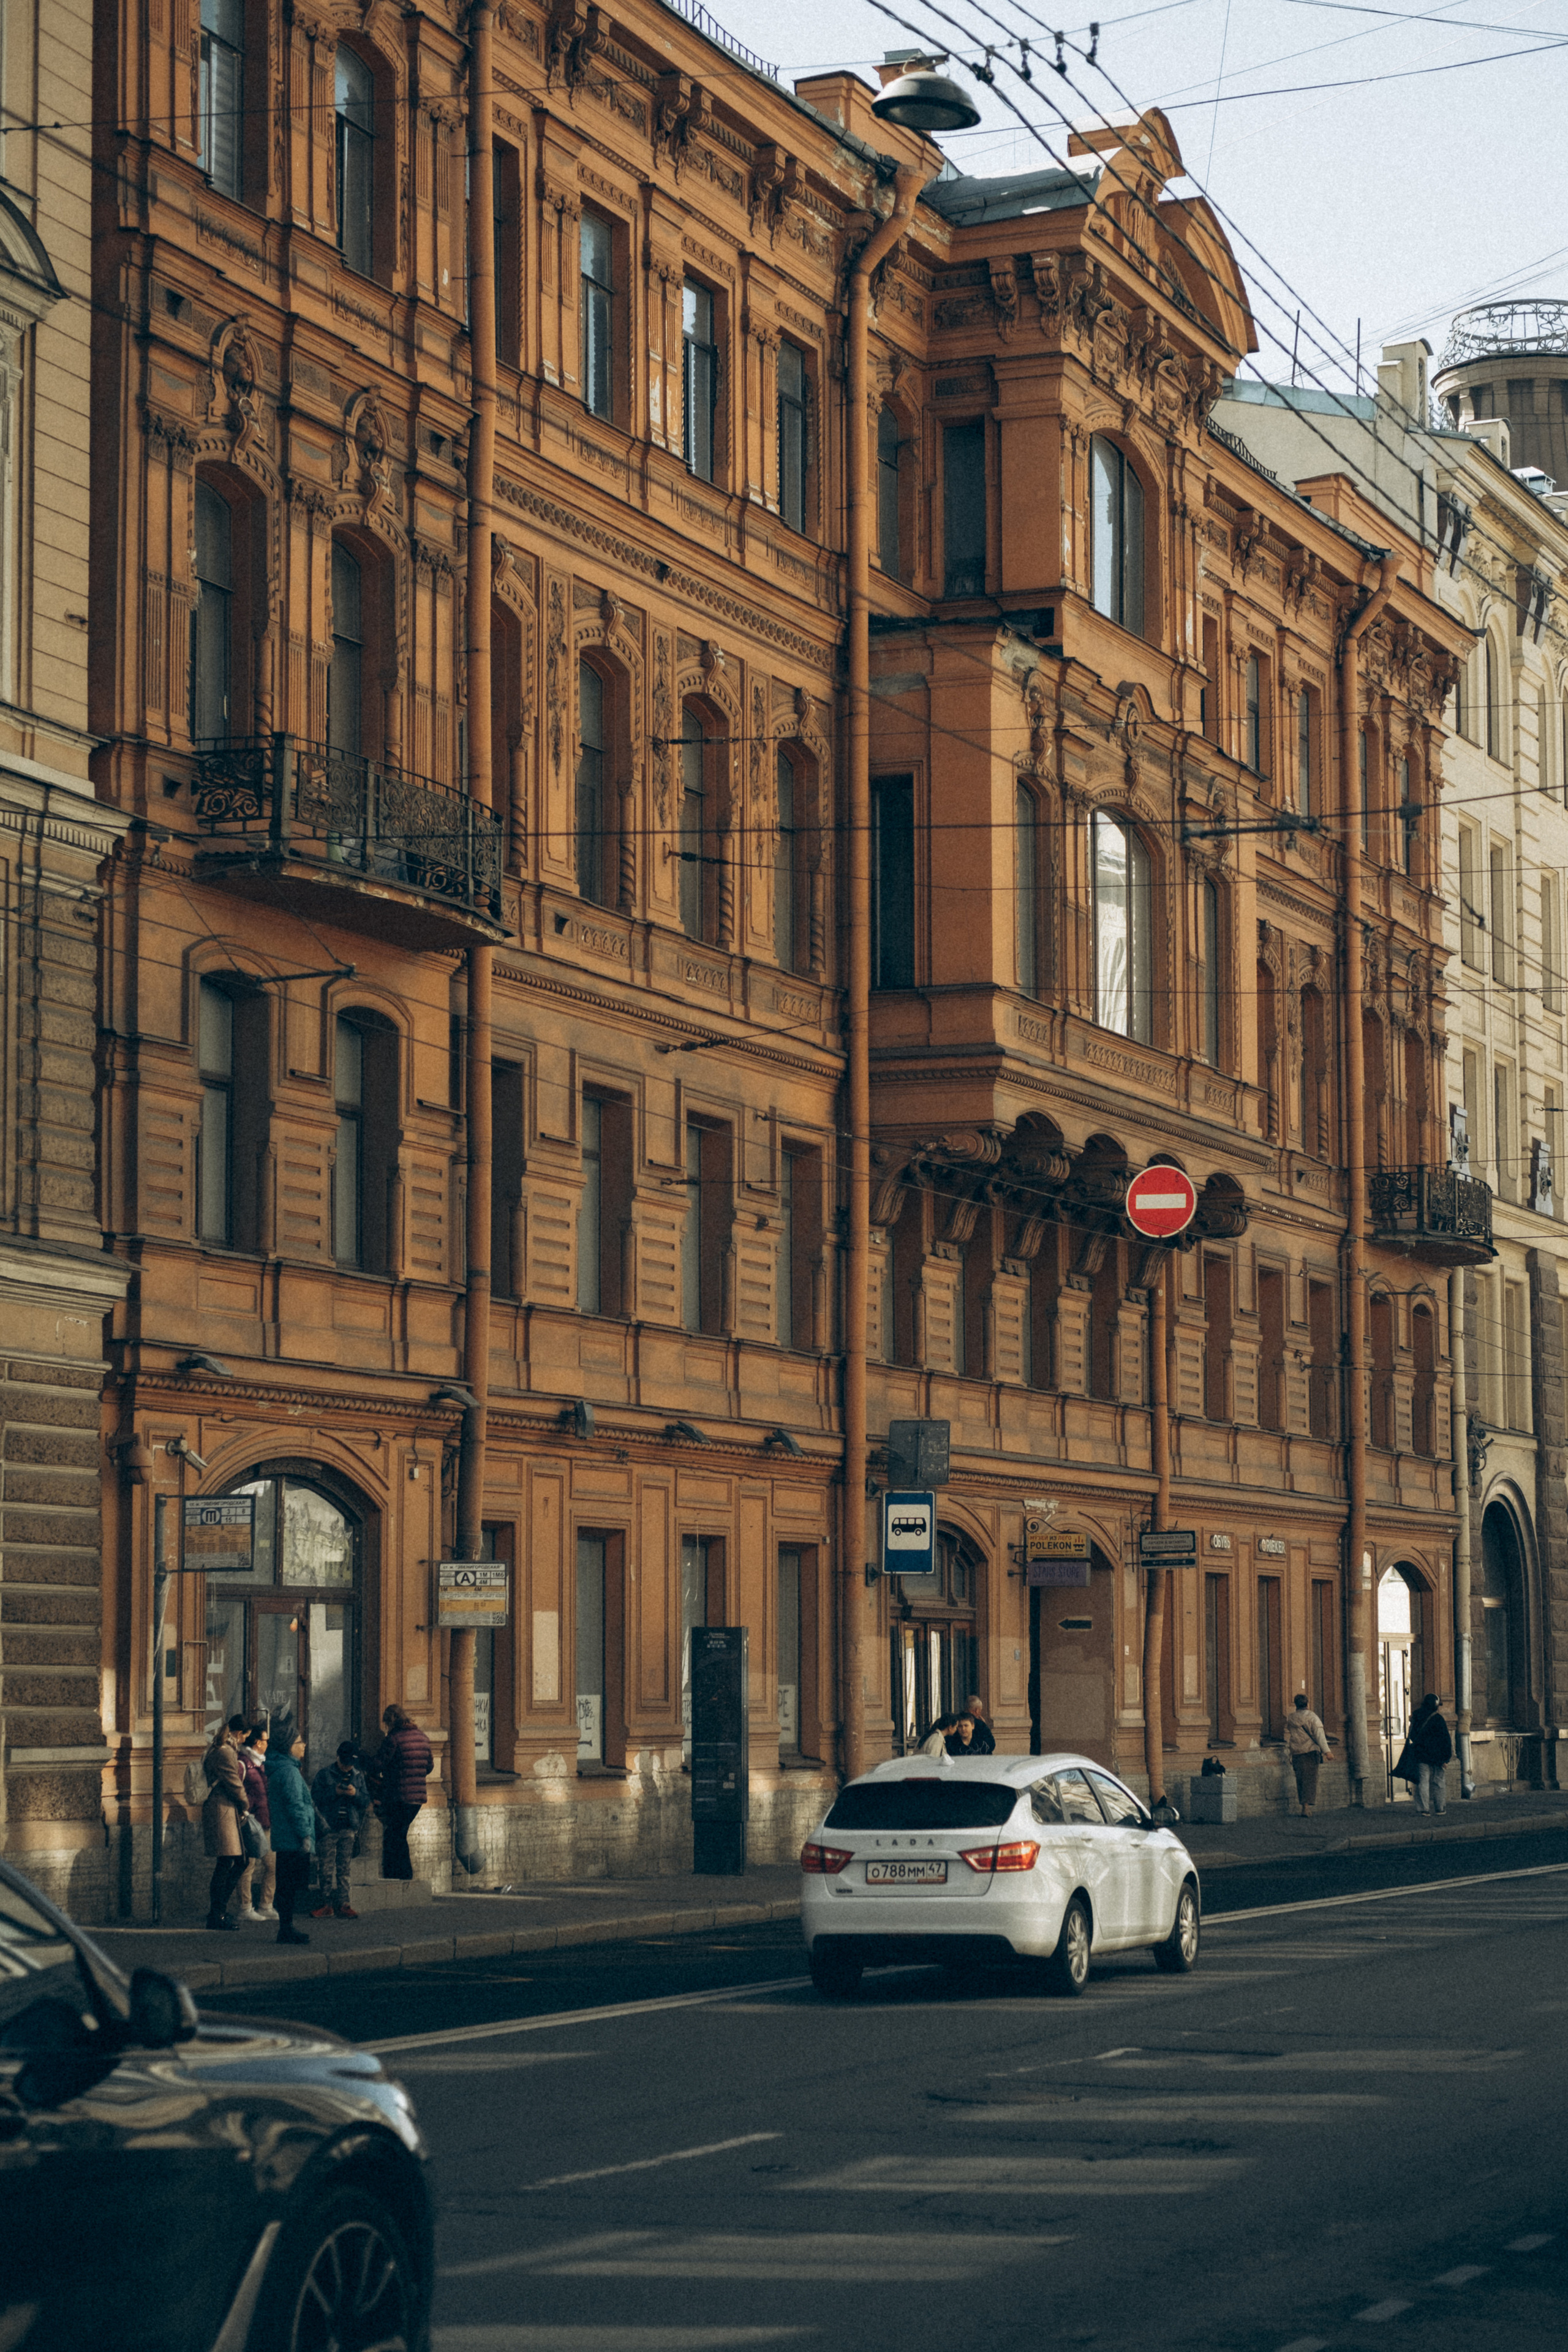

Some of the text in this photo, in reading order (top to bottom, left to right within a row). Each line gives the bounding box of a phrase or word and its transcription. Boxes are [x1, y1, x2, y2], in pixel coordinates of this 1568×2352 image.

[1213, 1534, 1231, 1549] ОБУВЬ
[460, 1572, 471, 1584] А
[1058, 1566, 1080, 1578] STORE
[265, 1691, 287, 1703] VAPE
[929, 1863, 941, 1873] 47
